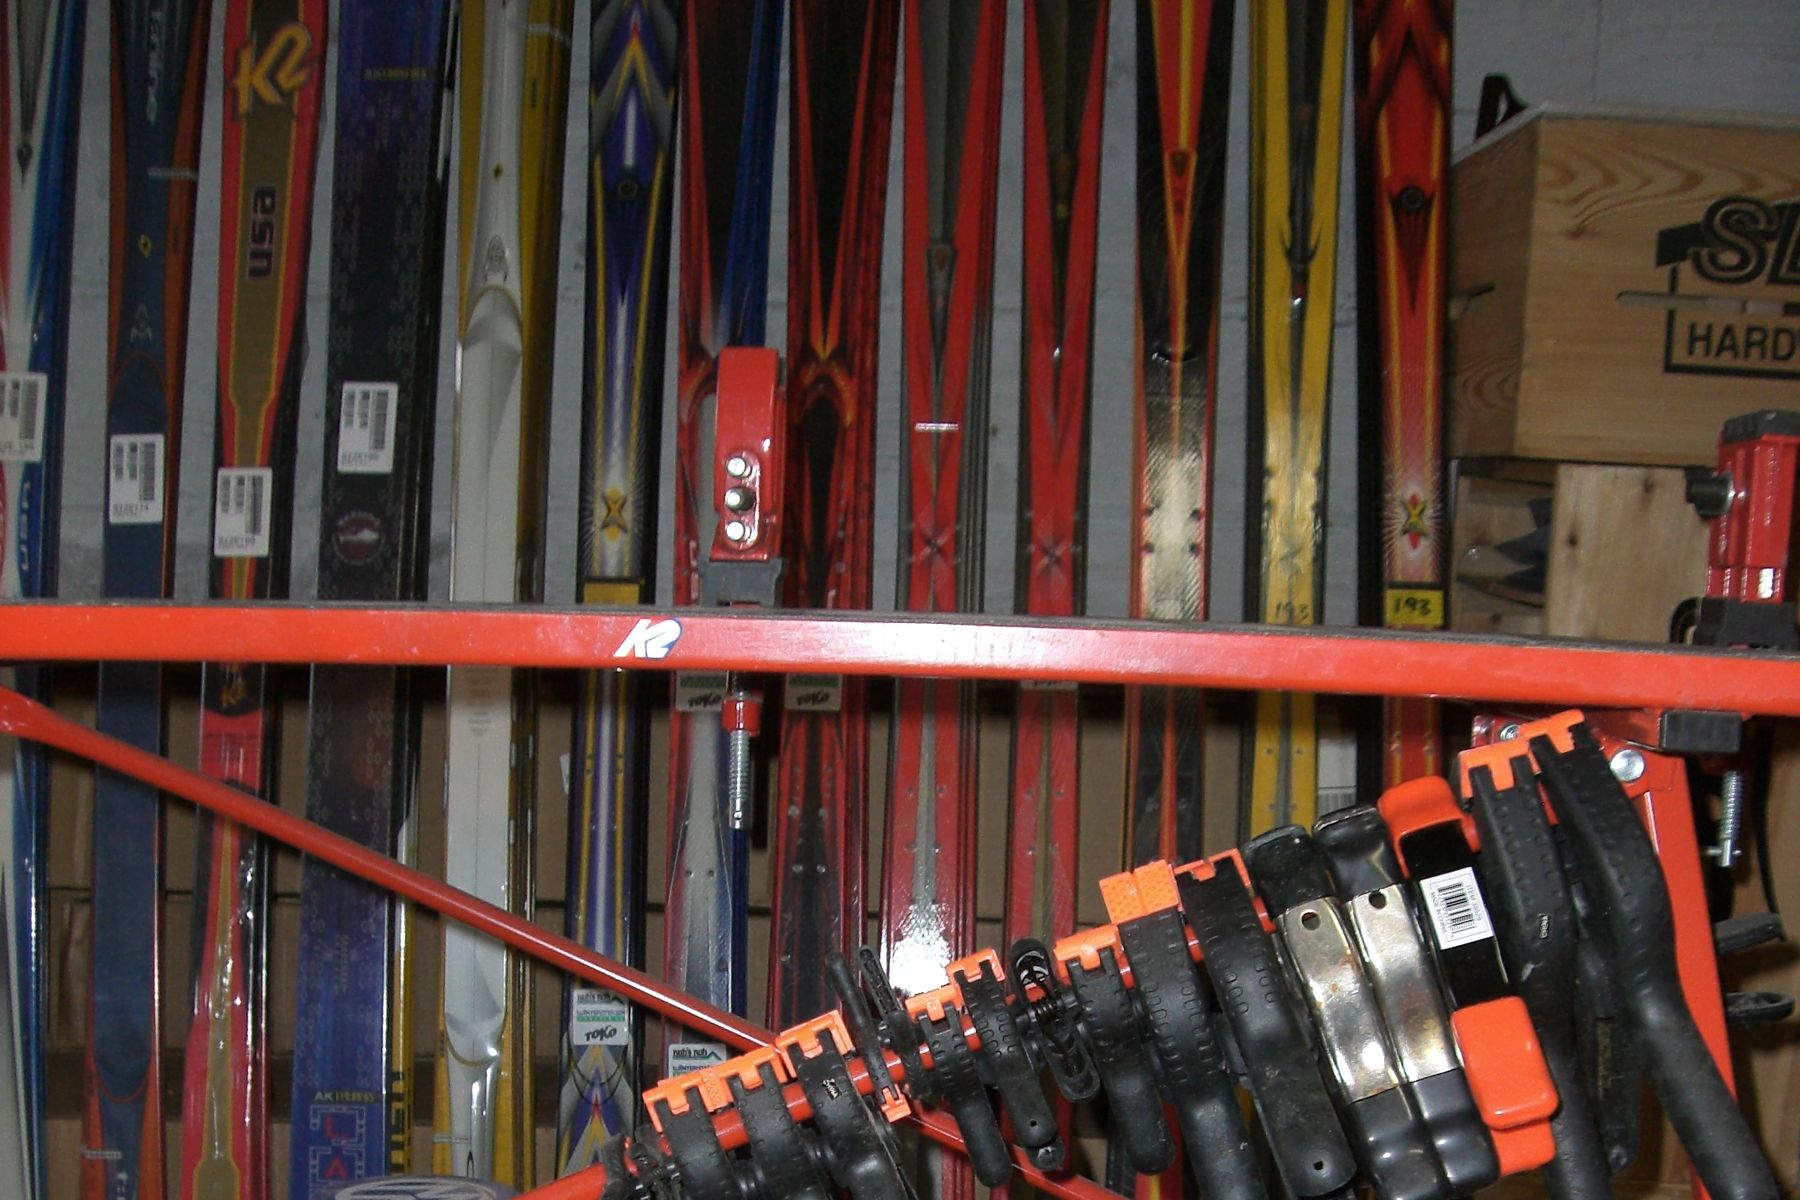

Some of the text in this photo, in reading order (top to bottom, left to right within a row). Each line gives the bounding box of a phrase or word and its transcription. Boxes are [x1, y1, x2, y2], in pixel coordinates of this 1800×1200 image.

[234, 22, 312, 118] K2
[1687, 321, 1800, 361] HARD
[1393, 597, 1431, 615] 193
[613, 617, 683, 660] K2
[584, 1025, 617, 1042] TOKO
